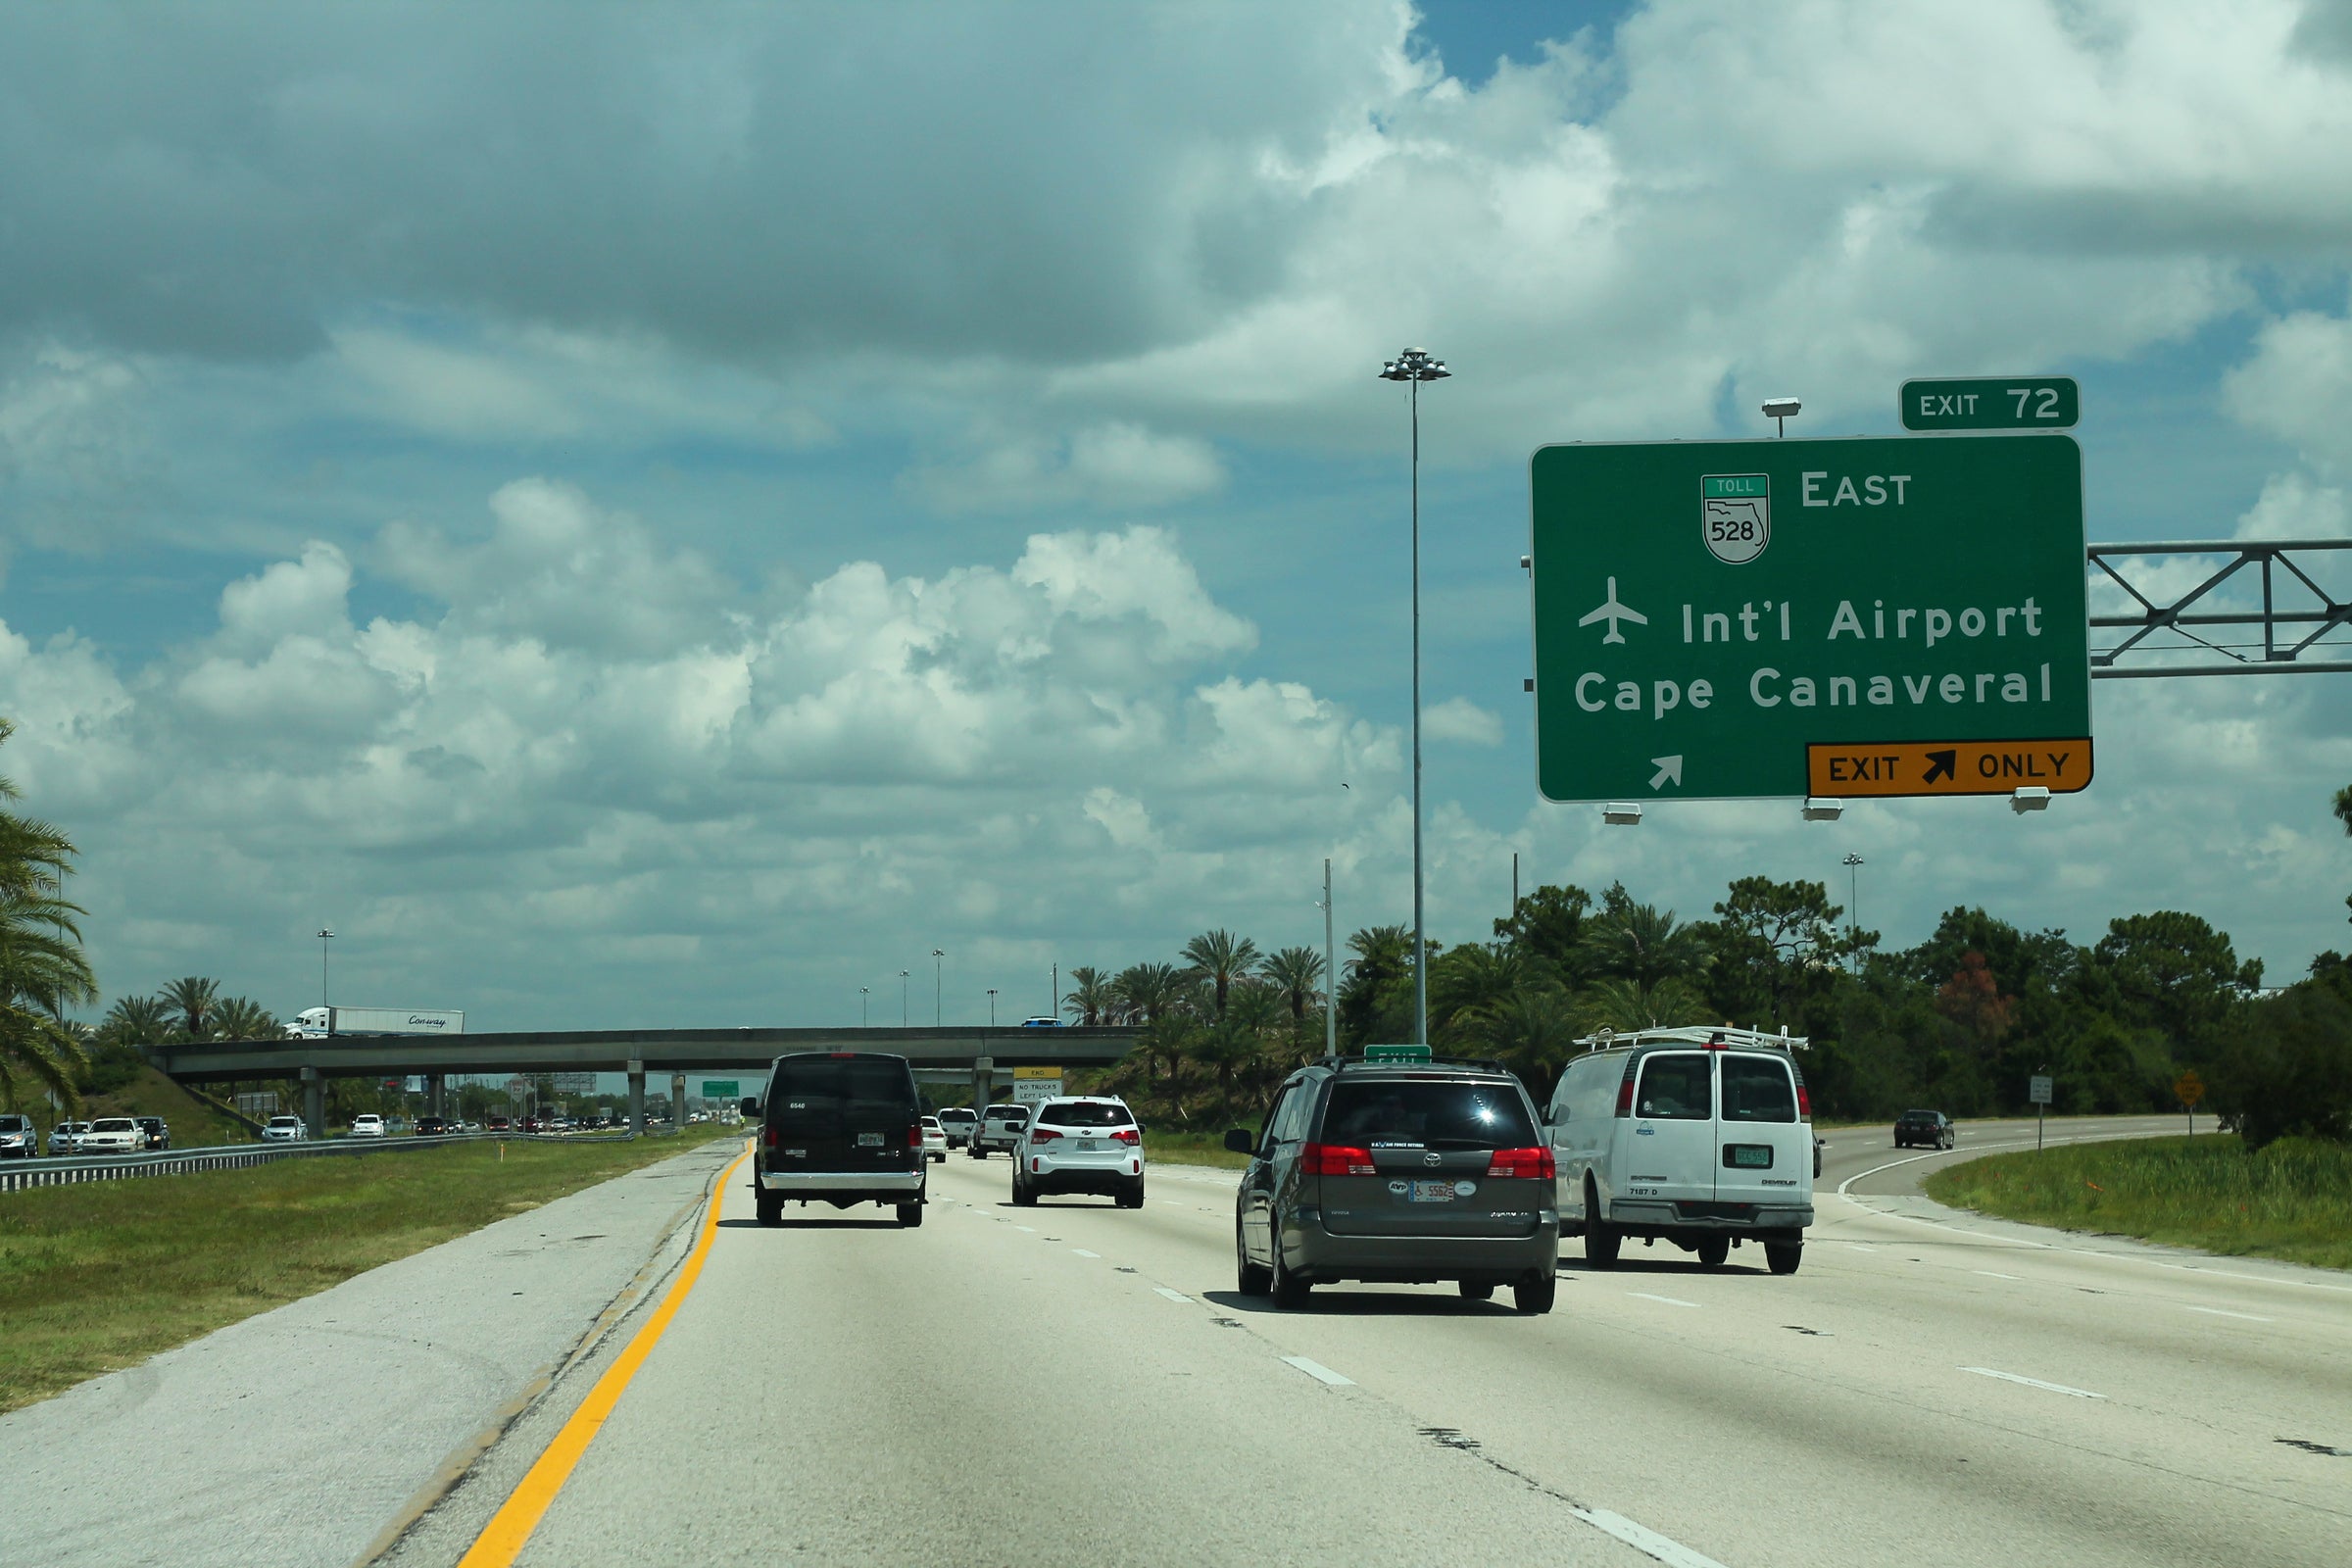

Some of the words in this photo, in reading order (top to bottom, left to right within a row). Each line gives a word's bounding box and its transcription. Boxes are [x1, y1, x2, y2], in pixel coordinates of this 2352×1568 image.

[1921, 394, 1979, 416] EXIT
[2007, 388, 2059, 418] 72
[1716, 478, 1754, 492] TOLL
[1801, 471, 1912, 507] EAST
[1711, 520, 1754, 542] 528
[1683, 600, 1790, 643] Int'l
[1827, 596, 2042, 648] Airport
[1575, 671, 1714, 720] Cape
[1749, 662, 2051, 708] Canaveral
[1829, 756, 1900, 781] EXIT
[1978, 753, 2070, 779] ONLY
